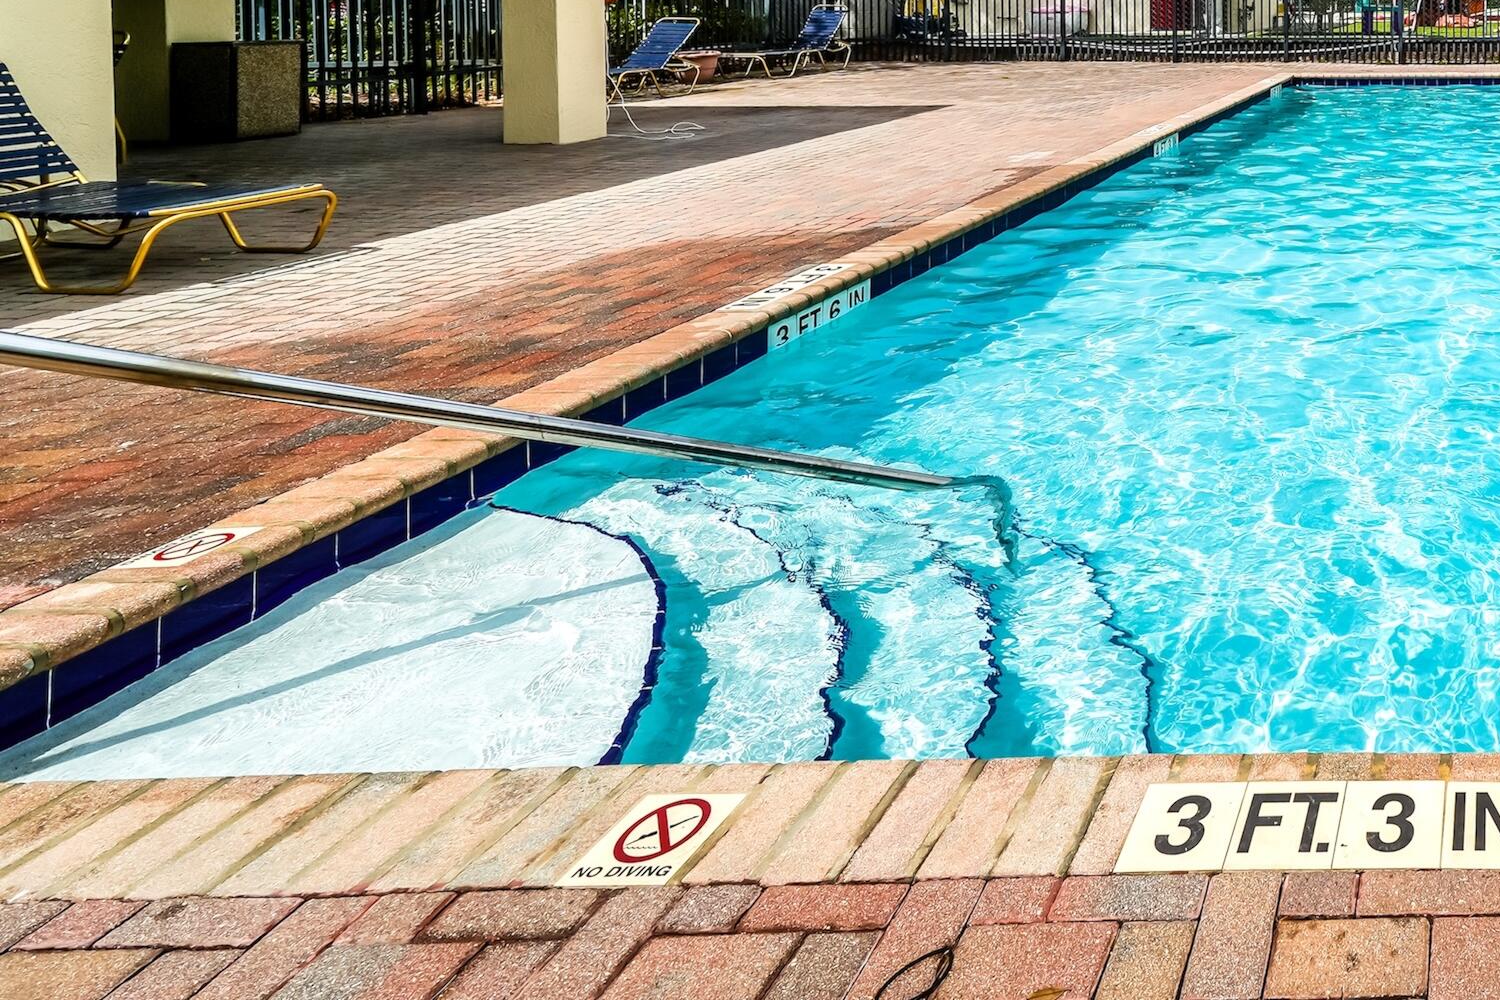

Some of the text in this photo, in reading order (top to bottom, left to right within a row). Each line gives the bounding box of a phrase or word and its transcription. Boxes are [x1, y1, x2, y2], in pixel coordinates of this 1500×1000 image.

[776, 324, 789, 347] 3
[829, 299, 841, 320] 6
[1154, 795, 1212, 855] 3
[1236, 792, 1338, 854] FT.
[1366, 793, 1416, 853] 3
[571, 865, 673, 878] NO DIVING
